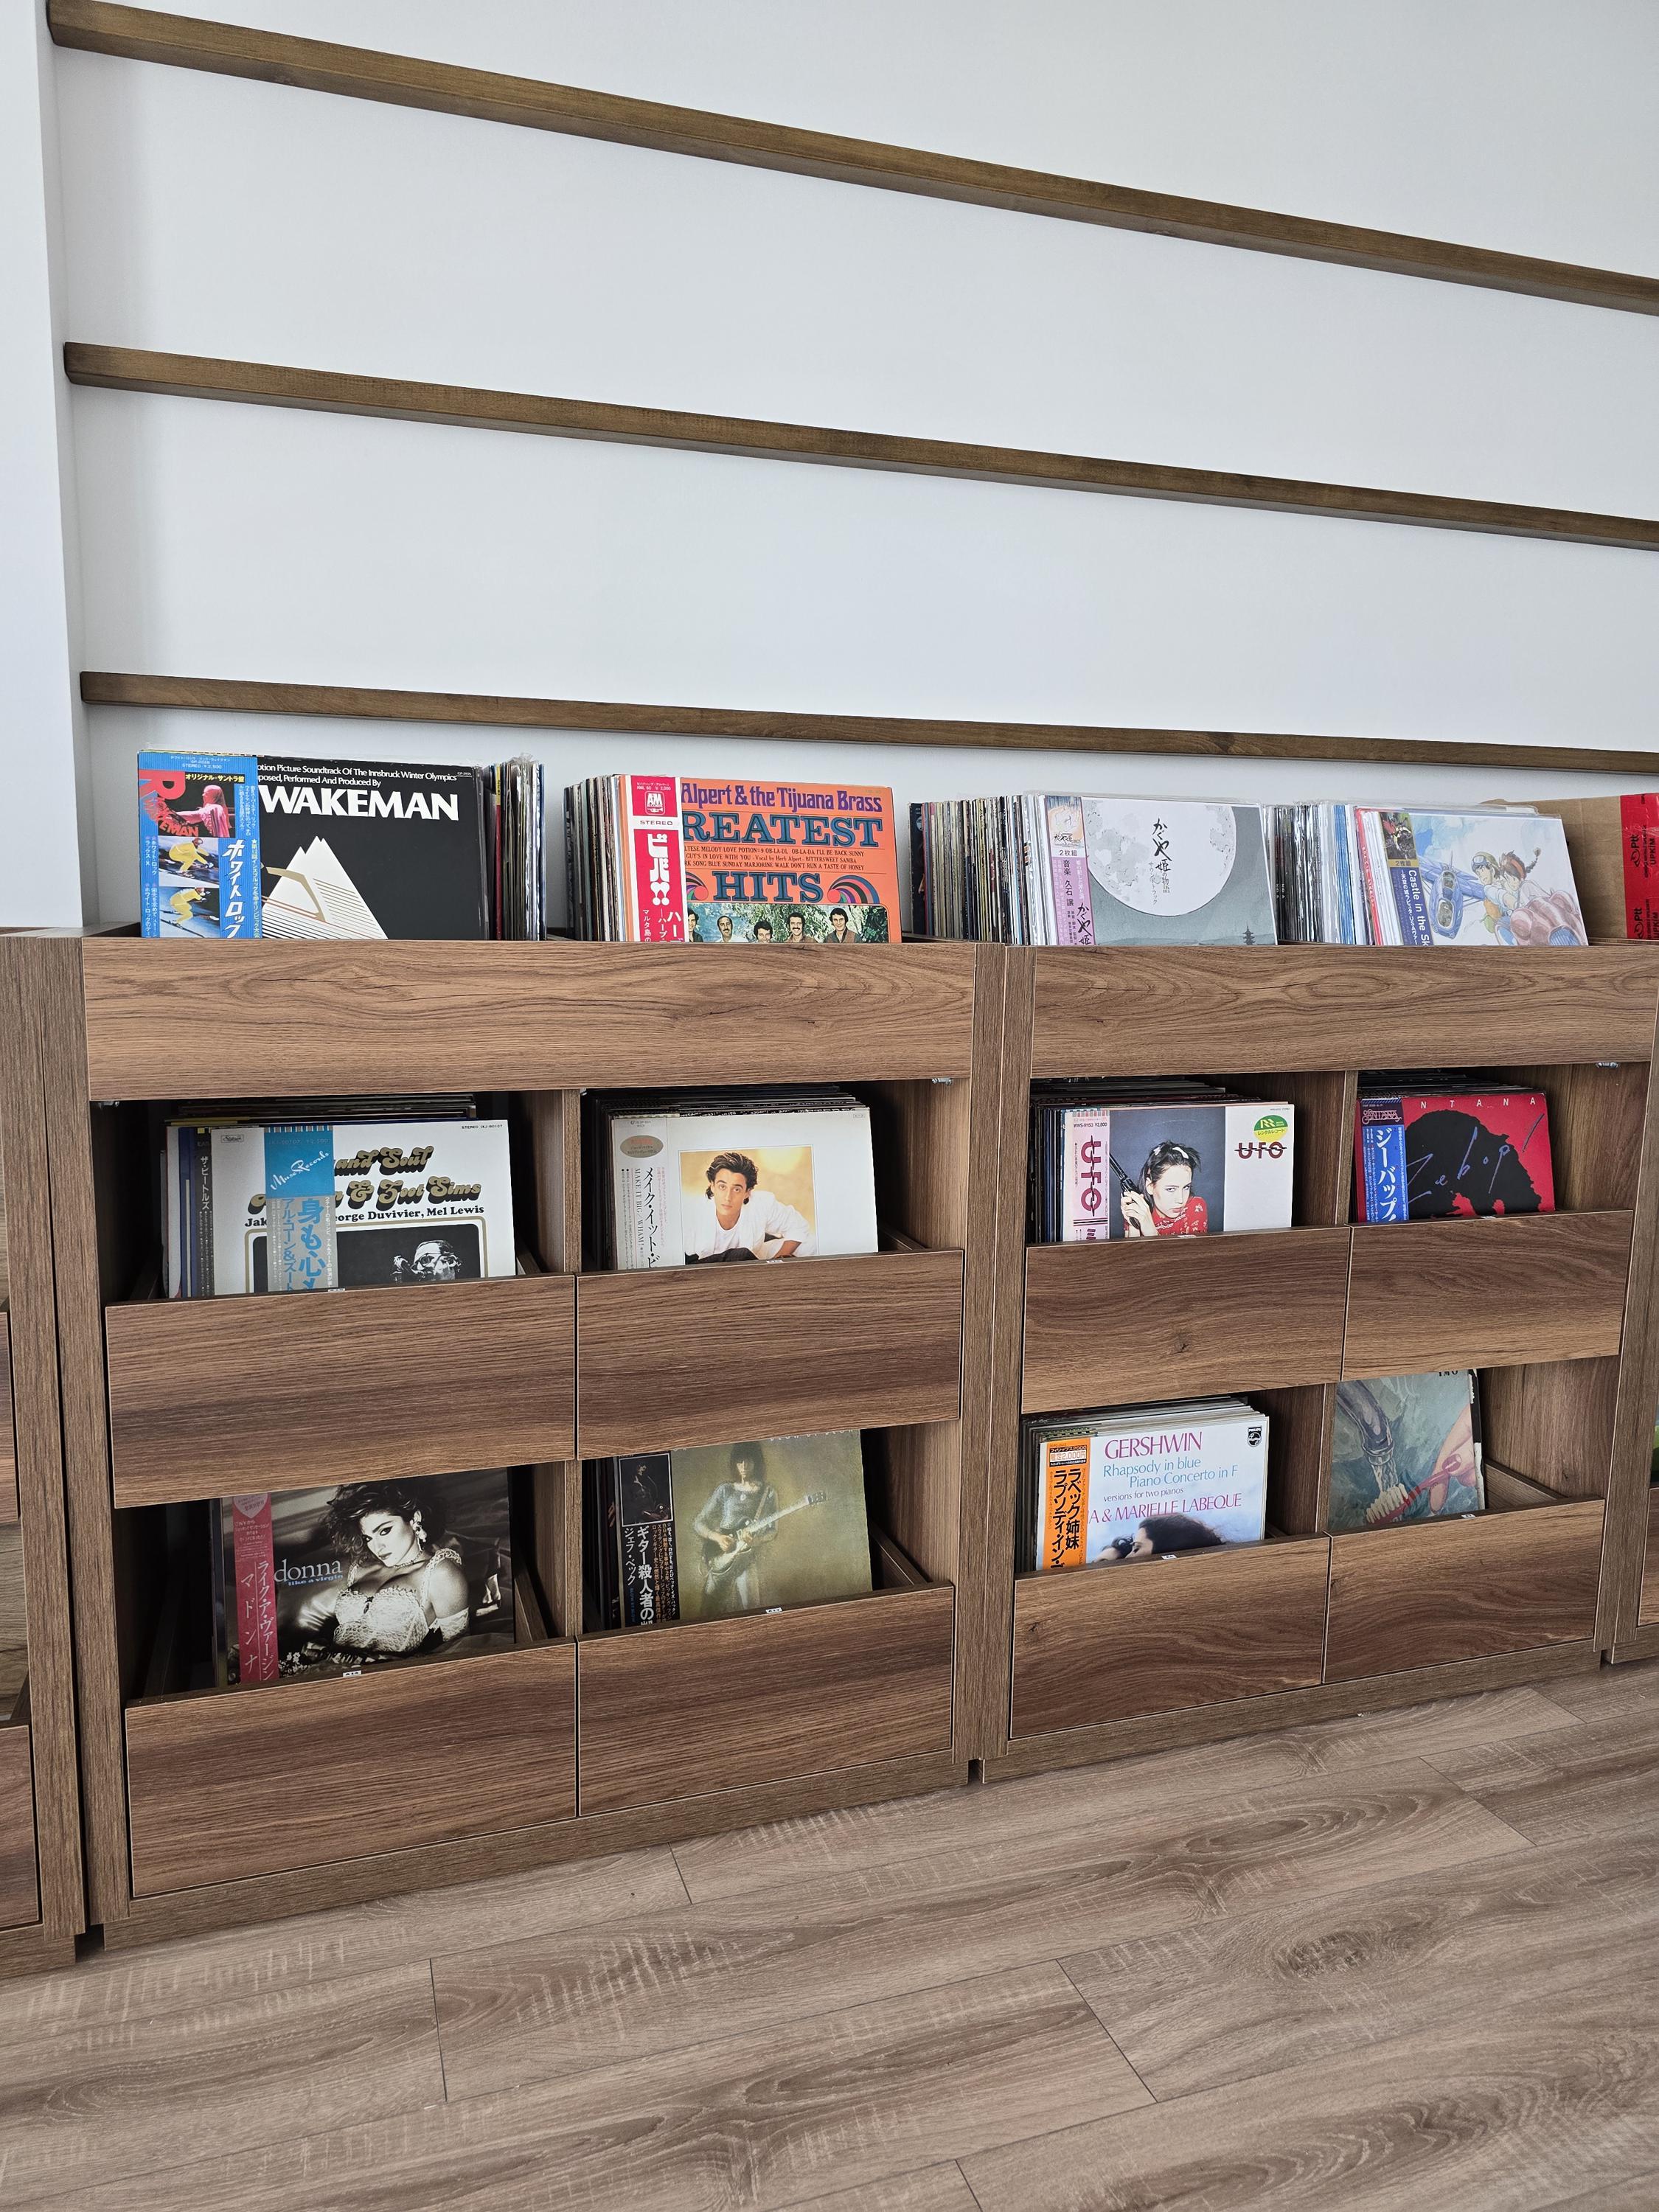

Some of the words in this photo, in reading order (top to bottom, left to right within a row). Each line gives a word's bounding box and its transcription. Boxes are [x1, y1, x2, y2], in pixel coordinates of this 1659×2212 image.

[257, 763, 276, 771] otion
[277, 764, 302, 773] Picture
[303, 765, 341, 775] Soundtrack
[342, 768, 353, 776] Of
[353, 768, 368, 776] The
[369, 770, 400, 779] Innsbruck
[400, 771, 424, 780] Winter
[425, 772, 458, 782] Olympics
[257, 773, 283, 783] posed,
[283, 774, 321, 784] Performed
[338, 777, 372, 787] Produced
[372, 779, 382, 788] By
[258, 785, 459, 821] WAKEMAN
[682, 782, 733, 809] Alpert
[734, 785, 748, 805] &
[750, 786, 776, 807] the
[776, 787, 834, 813] Tijuana
[836, 790, 883, 813] Brass
[684, 810, 883, 848] REATEST
[1063, 860, 1071, 876] 音楽
[712, 870, 824, 903] HITS
[1408, 870, 1420, 900] Castle
[1415, 904, 1423, 912] in
[1417, 916, 1426, 931] the
[1421, 934, 1430, 946] Sk
[1420, 1096, 1536, 1109] NTANA
[1257, 1128, 1286, 1136] レンタルレコード
[378, 1145, 435, 1176] Soul
[1234, 1141, 1287, 1160] UFO
[270, 1172, 296, 1190] Muse
[291, 1150, 330, 1172] Records
[1080, 1136, 1102, 1217] UFO
[348, 1180, 375, 1210] &
[425, 1175, 481, 1203] Sims
[245, 1217, 267, 1228] Jak
[335, 1212, 365, 1223] eorge
[367, 1208, 425, 1220] Duvivier,
[426, 1207, 450, 1217] Mel
[452, 1204, 484, 1215] Lewis
[1105, 1431, 1203, 1459] GERSHWIN
[1103, 1459, 1161, 1478] Rhapsody
[1164, 1459, 1174, 1471] in
[1178, 1456, 1201, 1470] blue
[1130, 1475, 1161, 1488] Piano
[1164, 1469, 1215, 1484] Concerto
[1218, 1467, 1228, 1478] in
[1231, 1464, 1239, 1477] F
[1103, 1492, 1133, 1502] versions
[1134, 1490, 1144, 1499] for
[1145, 1489, 1159, 1498] two
[1161, 1487, 1184, 1500] pianos
[1065, 1468, 1082, 1550] ラベック姉妹
[1102, 1508, 1113, 1523] &
[1115, 1500, 1179, 1522] MARIELLE
[1182, 1493, 1242, 1512] LABEQUE
[625, 1527, 636, 1586] ジェフ・ベック
[274, 1558, 344, 1582] donna
[288, 1579, 307, 1587] like
[316, 1573, 344, 1583] virgin
[240, 1573, 258, 1674] マドンナ
[257, 1560, 274, 1681] ライク・ア・ヴァージン
